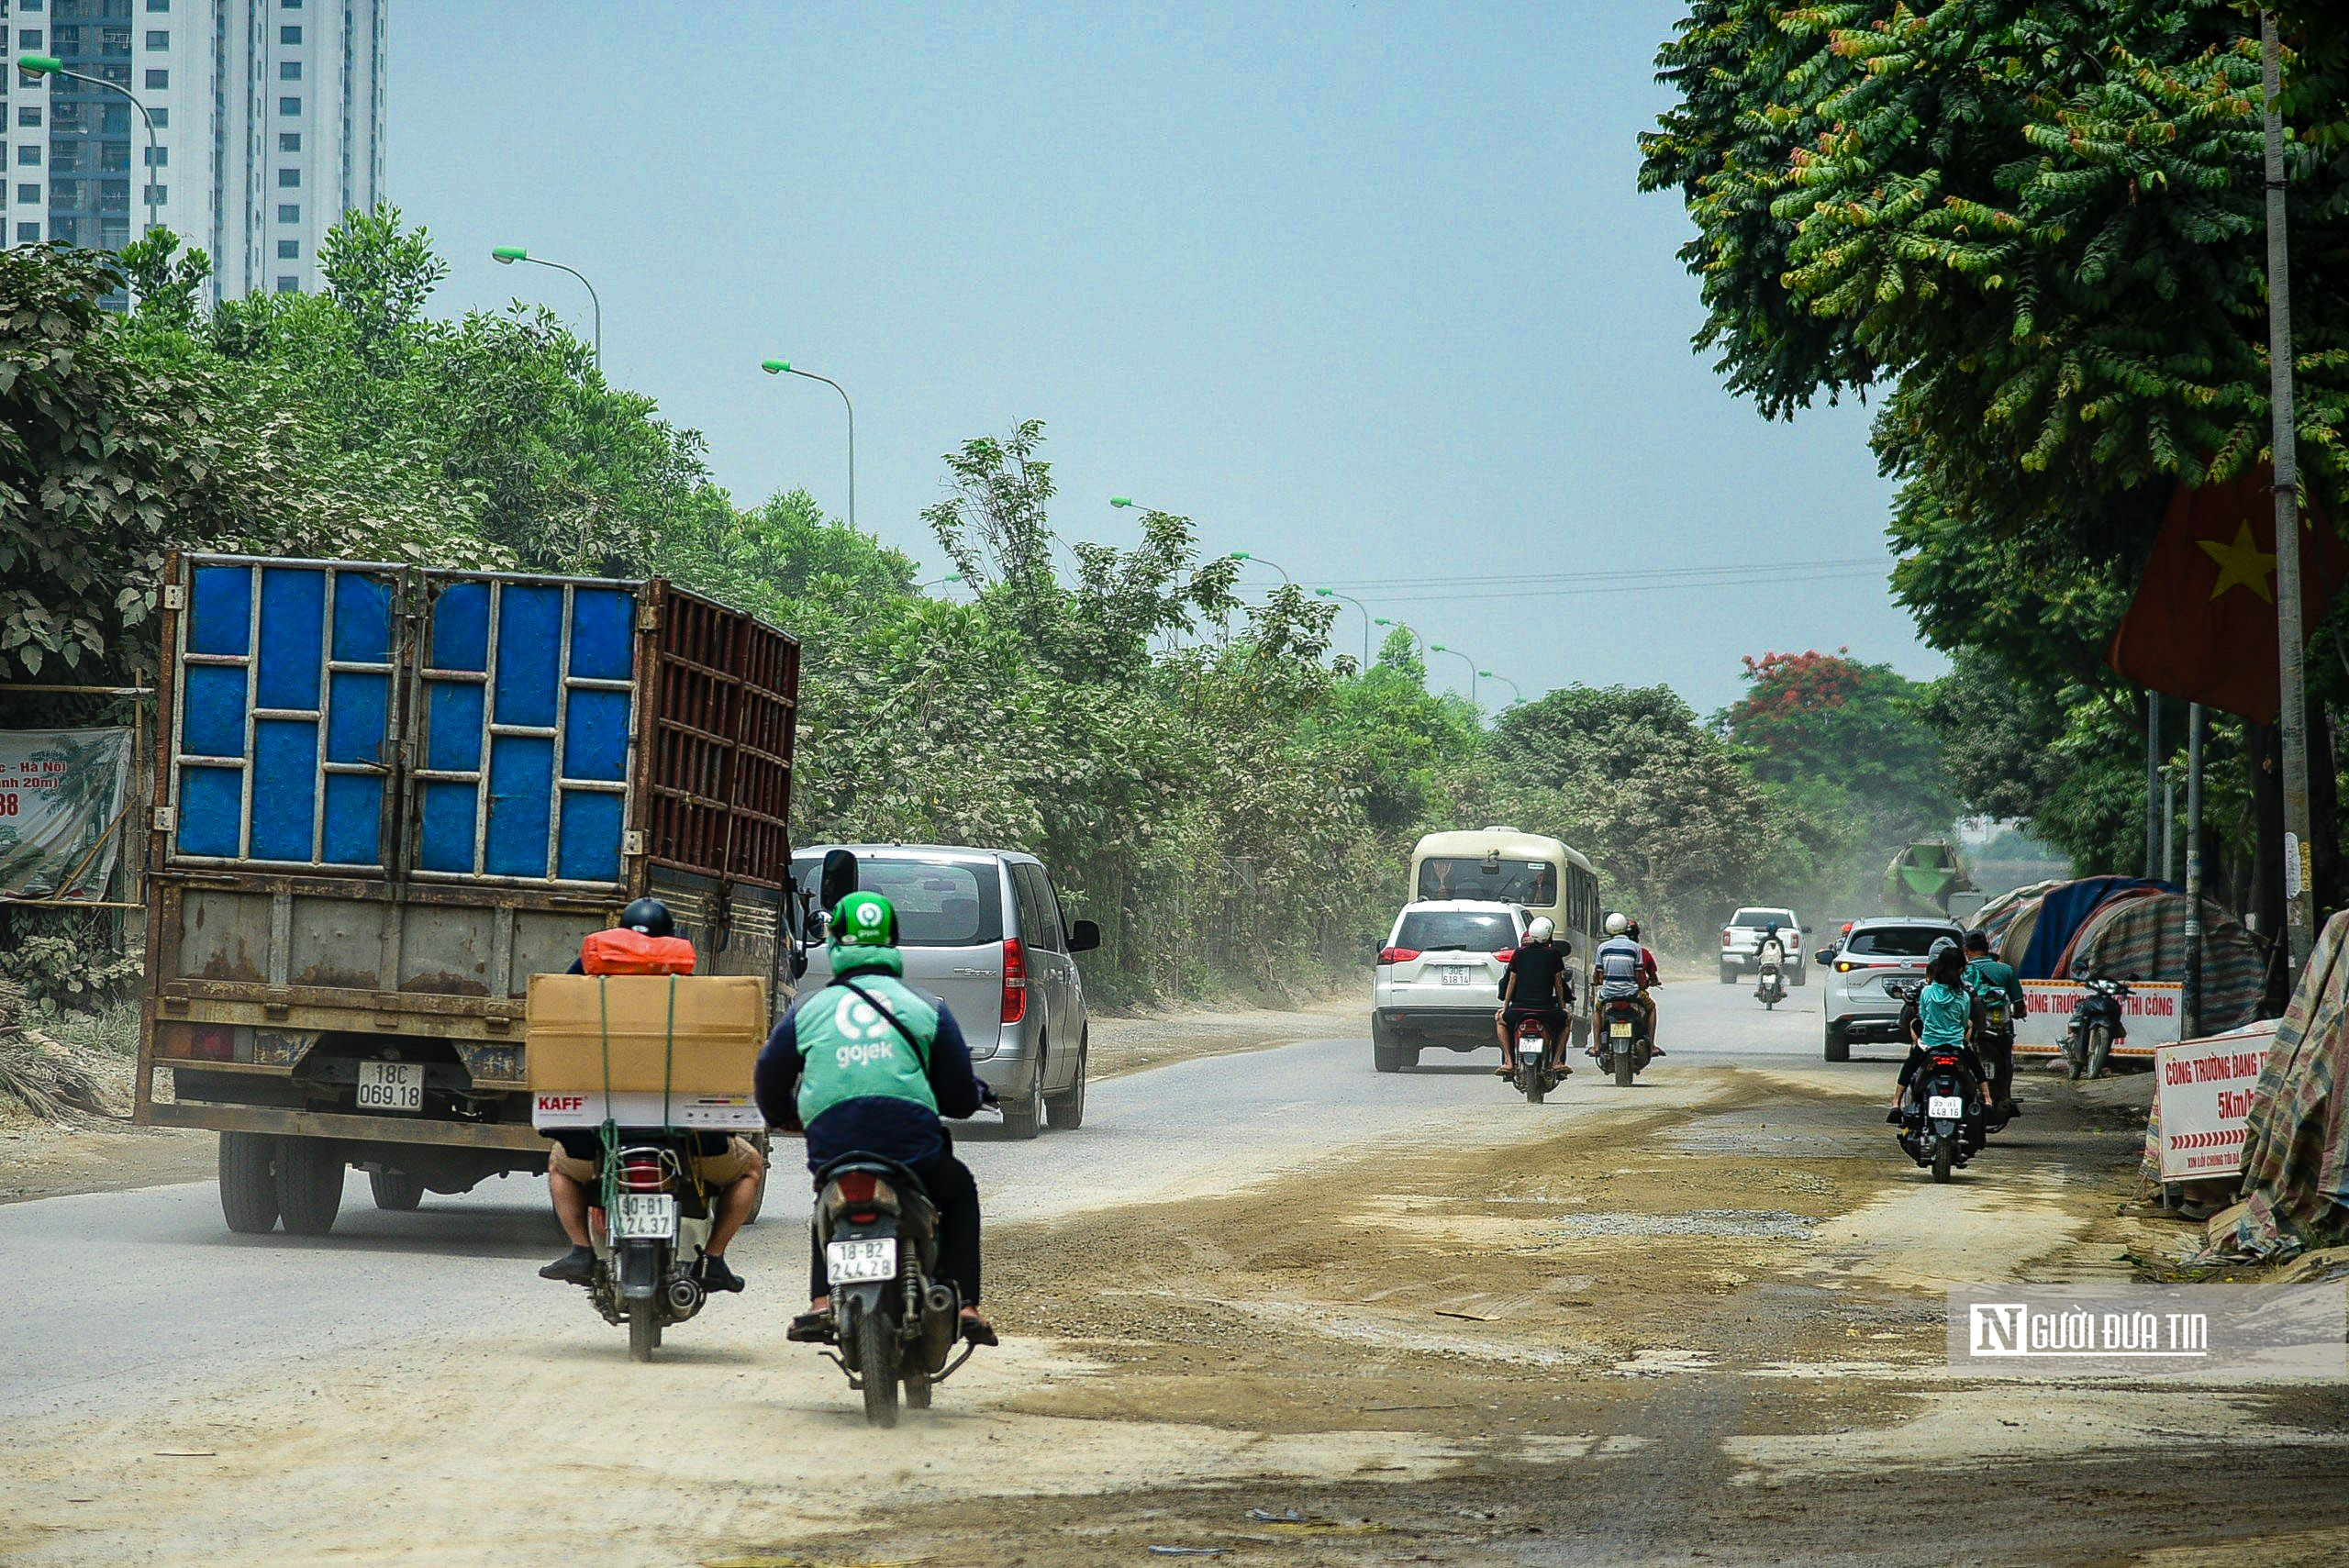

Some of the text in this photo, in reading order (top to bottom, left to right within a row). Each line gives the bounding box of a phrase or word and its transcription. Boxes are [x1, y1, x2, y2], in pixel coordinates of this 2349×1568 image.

[20, 762, 38, 773] Hà
[23, 777, 58, 788] 20m)
[2127, 996, 2143, 1016] THI
[2145, 993, 2173, 1017] CÔNG
[835, 1040, 894, 1069] gojek
[376, 1064, 407, 1084] 18C
[2165, 1057, 2192, 1085] CÔNG
[2193, 1051, 2231, 1083] TRƯỜNG
[360, 1084, 419, 1106] 069.18
[539, 1096, 583, 1110] KAFF
